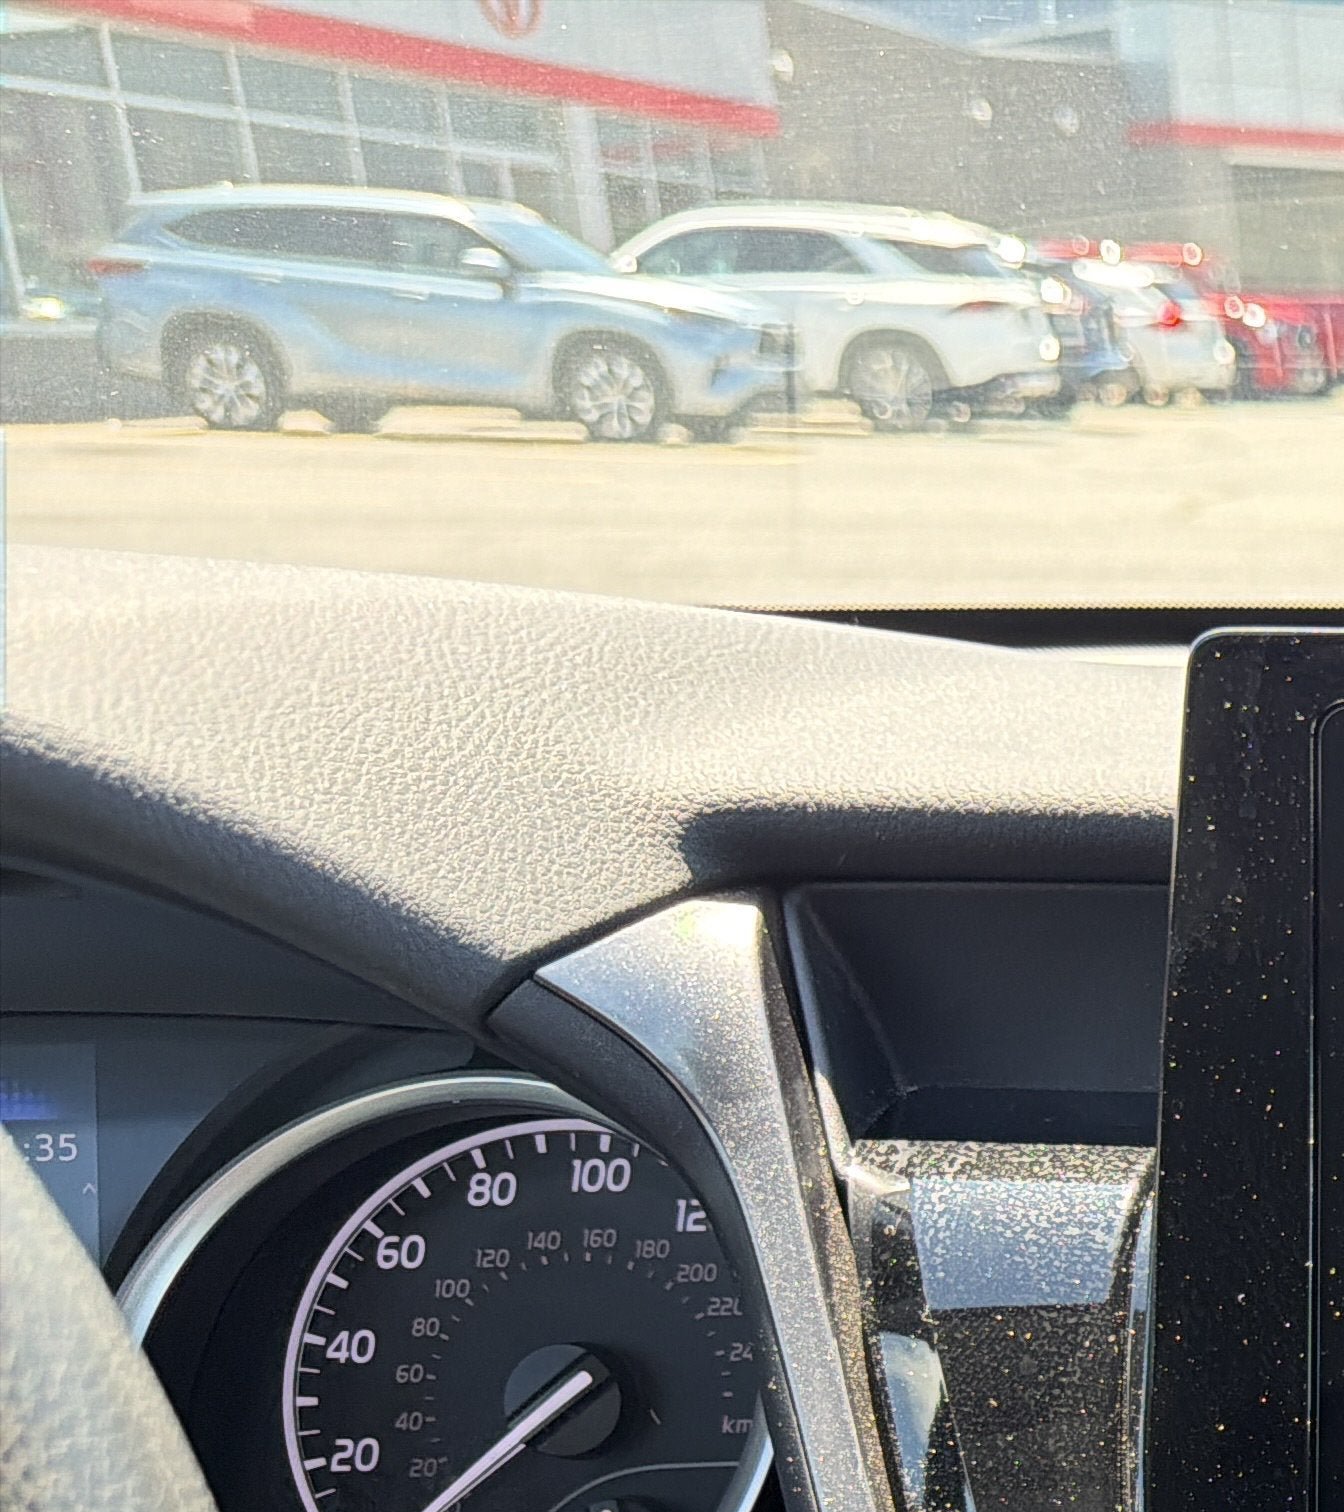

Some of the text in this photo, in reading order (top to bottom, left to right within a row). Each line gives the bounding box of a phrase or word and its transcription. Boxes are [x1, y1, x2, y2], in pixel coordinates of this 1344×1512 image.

[23, 1133, 78, 1163] :35
[571, 1158, 631, 1193] 100
[467, 1172, 517, 1207] 80
[675, 1199, 708, 1233] 12
[527, 1231, 561, 1250] 140
[583, 1228, 617, 1248] 160
[376, 1234, 426, 1270] 60
[475, 1249, 510, 1269] 120
[635, 1239, 670, 1259] 180
[677, 1263, 718, 1283] 200
[435, 1279, 471, 1298] 100
[411, 1317, 440, 1336] 80
[325, 1329, 376, 1364] 40
[730, 1343, 753, 1361] 24
[395, 1364, 424, 1383] 60
[395, 1411, 423, 1431] 40
[330, 1438, 379, 1472] 20
[409, 1458, 437, 1477] 20
